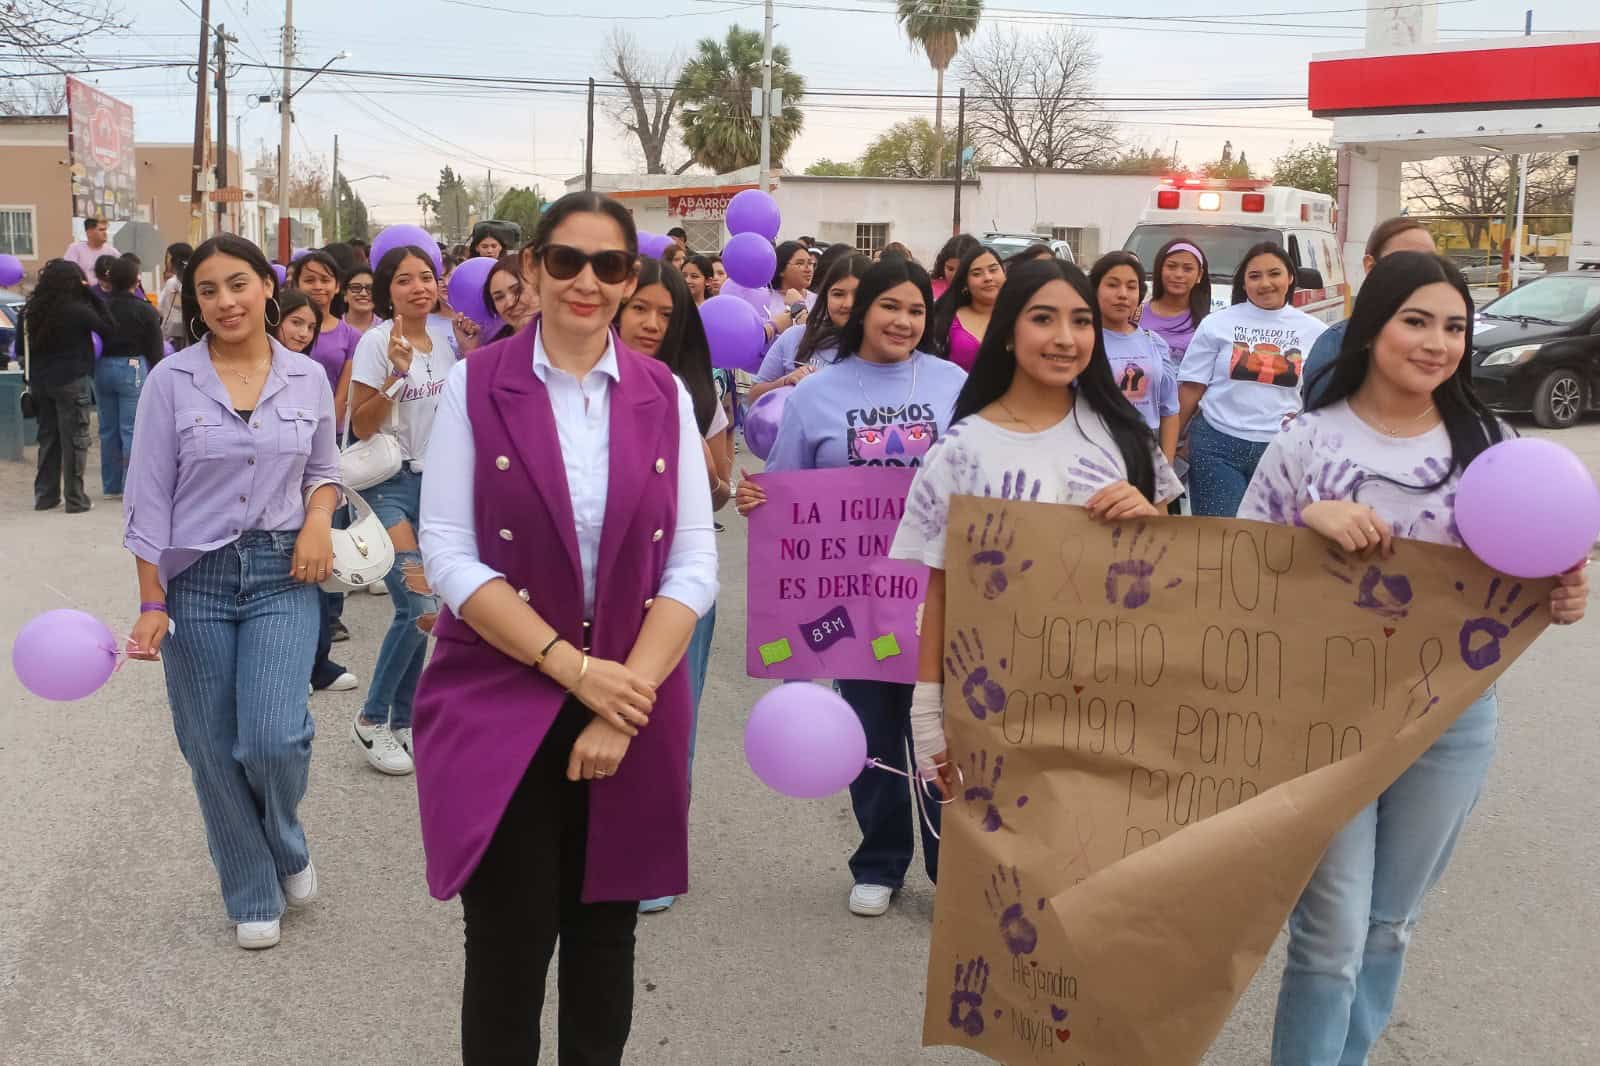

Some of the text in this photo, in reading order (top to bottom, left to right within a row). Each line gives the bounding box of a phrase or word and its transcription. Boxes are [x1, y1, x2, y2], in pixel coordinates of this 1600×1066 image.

[846, 403, 935, 426] FUIMOS
[792, 502, 821, 525] LA
[780, 537, 811, 561] NO
[821, 537, 847, 561] ES
[1194, 527, 1295, 616] HOY
[779, 573, 919, 600] ES DERECHO
[1201, 624, 1283, 701] con
